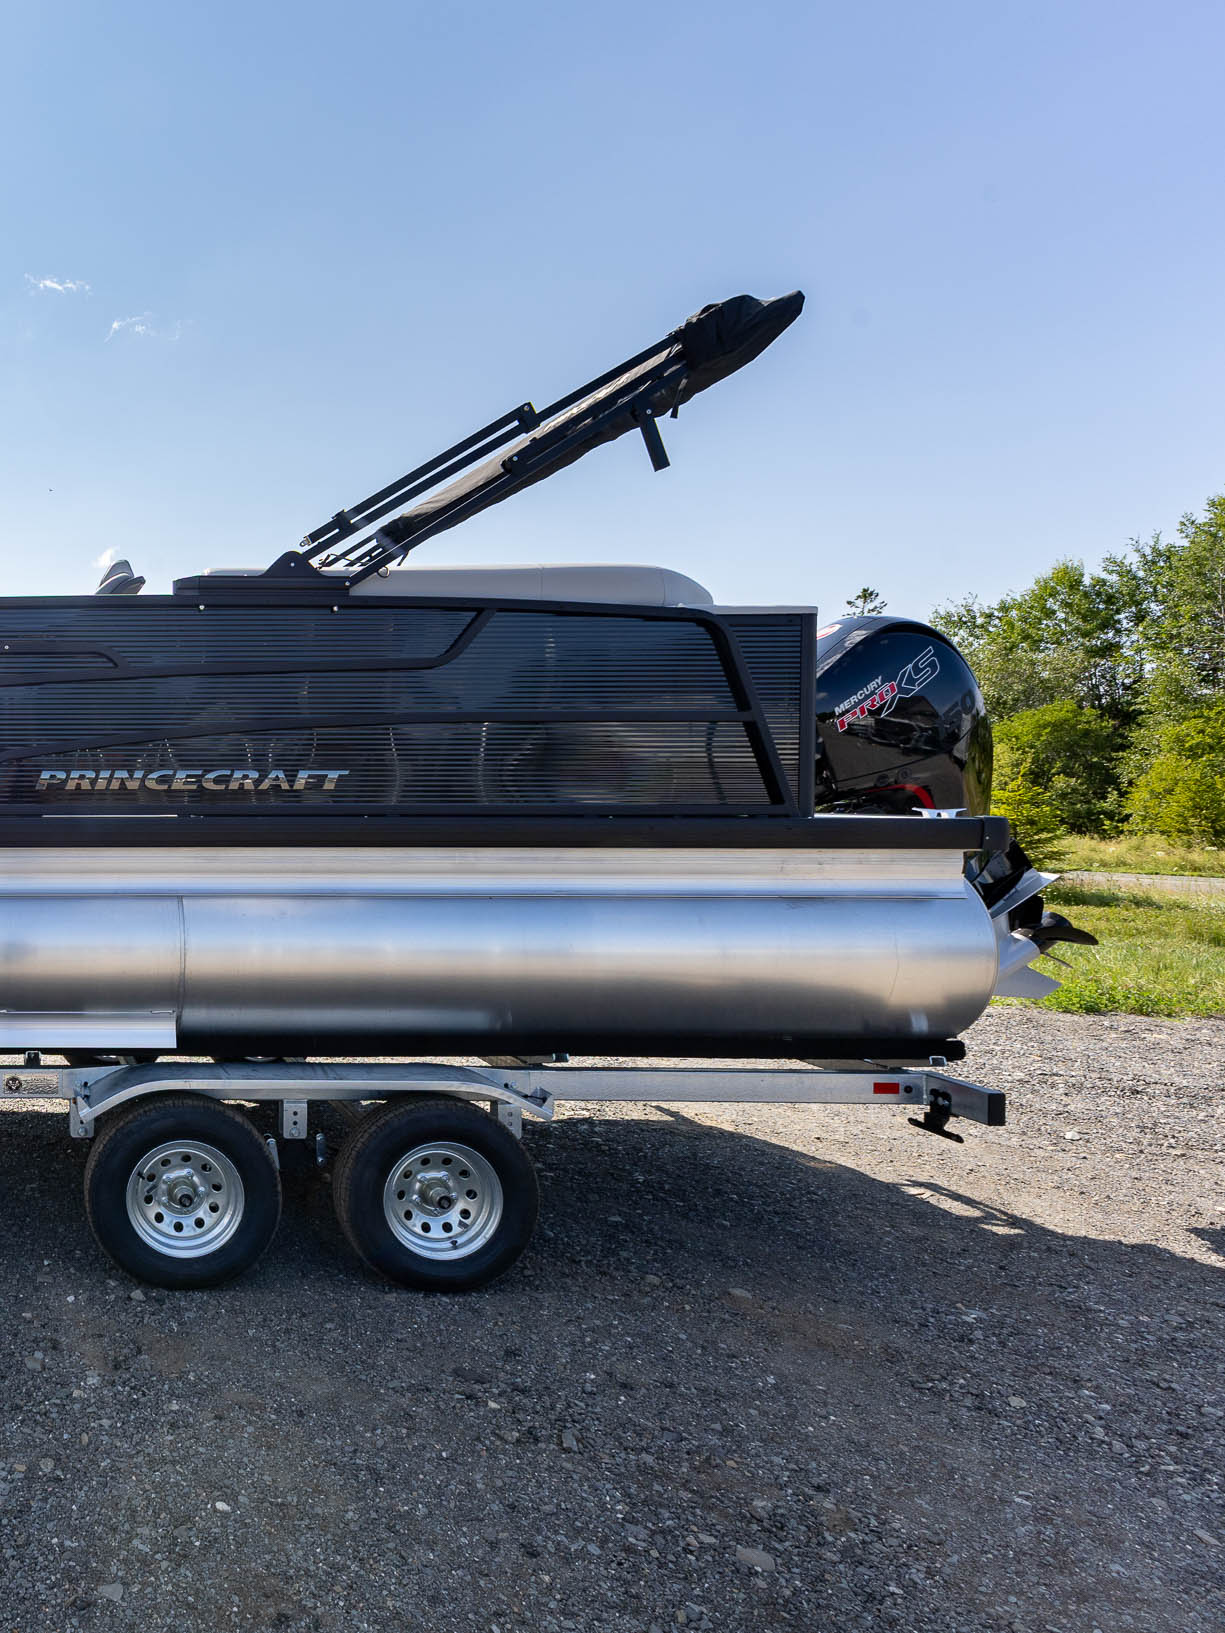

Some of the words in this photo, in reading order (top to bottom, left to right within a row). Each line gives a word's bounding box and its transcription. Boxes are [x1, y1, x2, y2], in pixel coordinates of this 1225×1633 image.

[834, 675, 883, 716] MERCURY
[837, 681, 897, 733] PRO
[880, 645, 940, 719] XS
[34, 769, 350, 790] PRINCECRAFT
